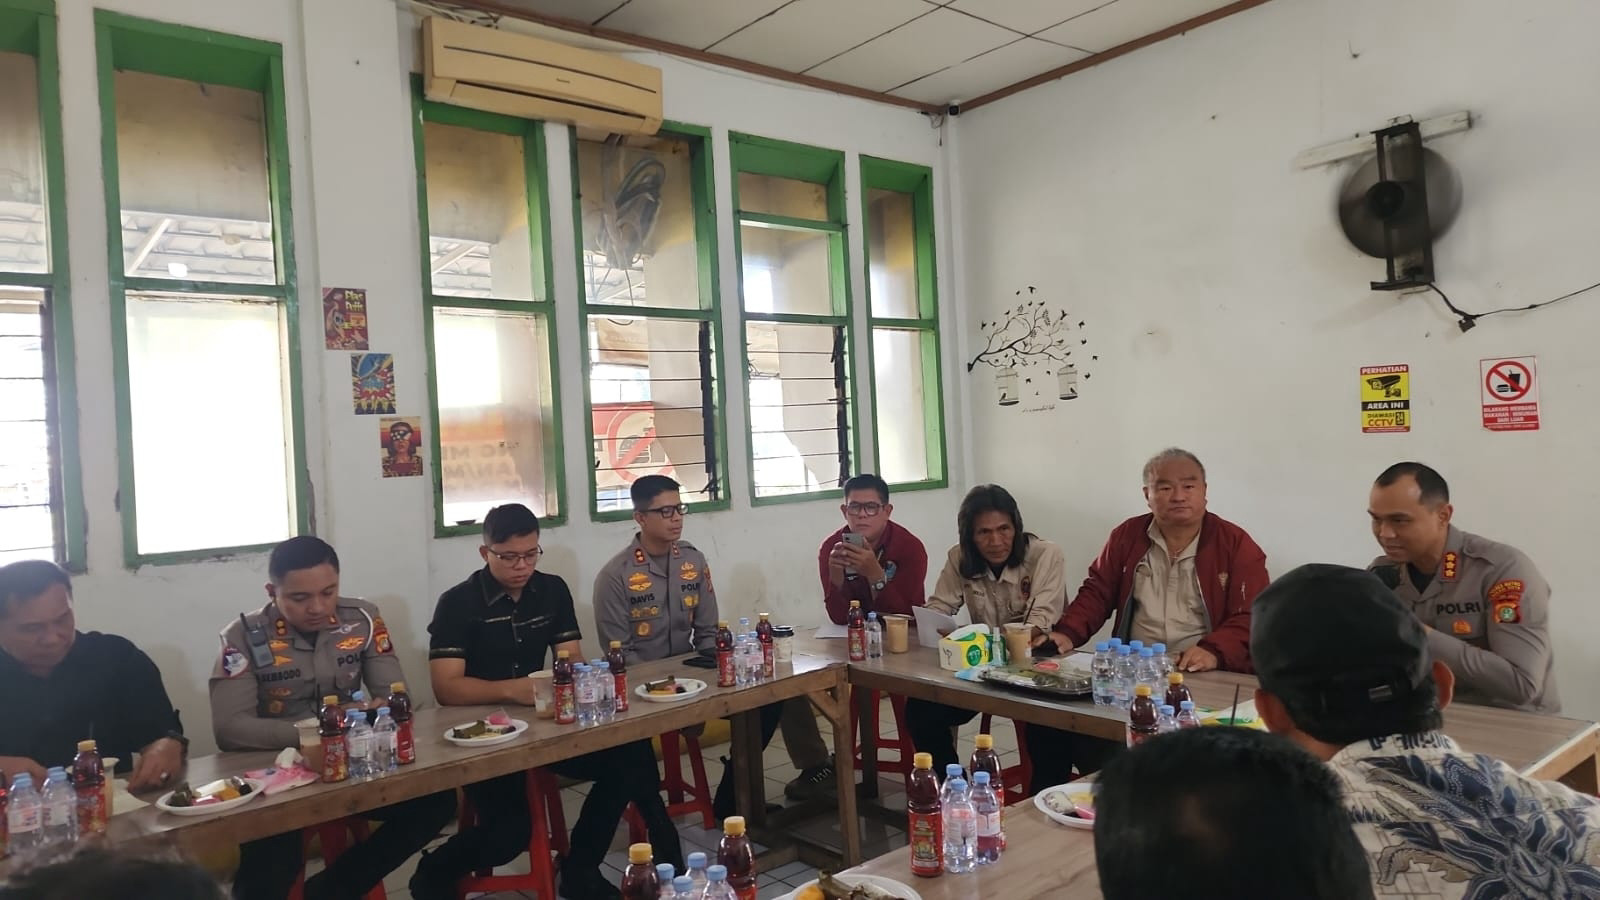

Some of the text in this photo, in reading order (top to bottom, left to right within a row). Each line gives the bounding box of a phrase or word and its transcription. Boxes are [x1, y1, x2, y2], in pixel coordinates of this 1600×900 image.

[1362, 365, 1407, 374] PERHATIAN
[1367, 401, 1404, 410] AREA INI
[1368, 418, 1394, 427] CCTV
[630, 593, 655, 605] DAVIS
[1437, 602, 1480, 615] POLRI
[337, 654, 361, 667] POL
